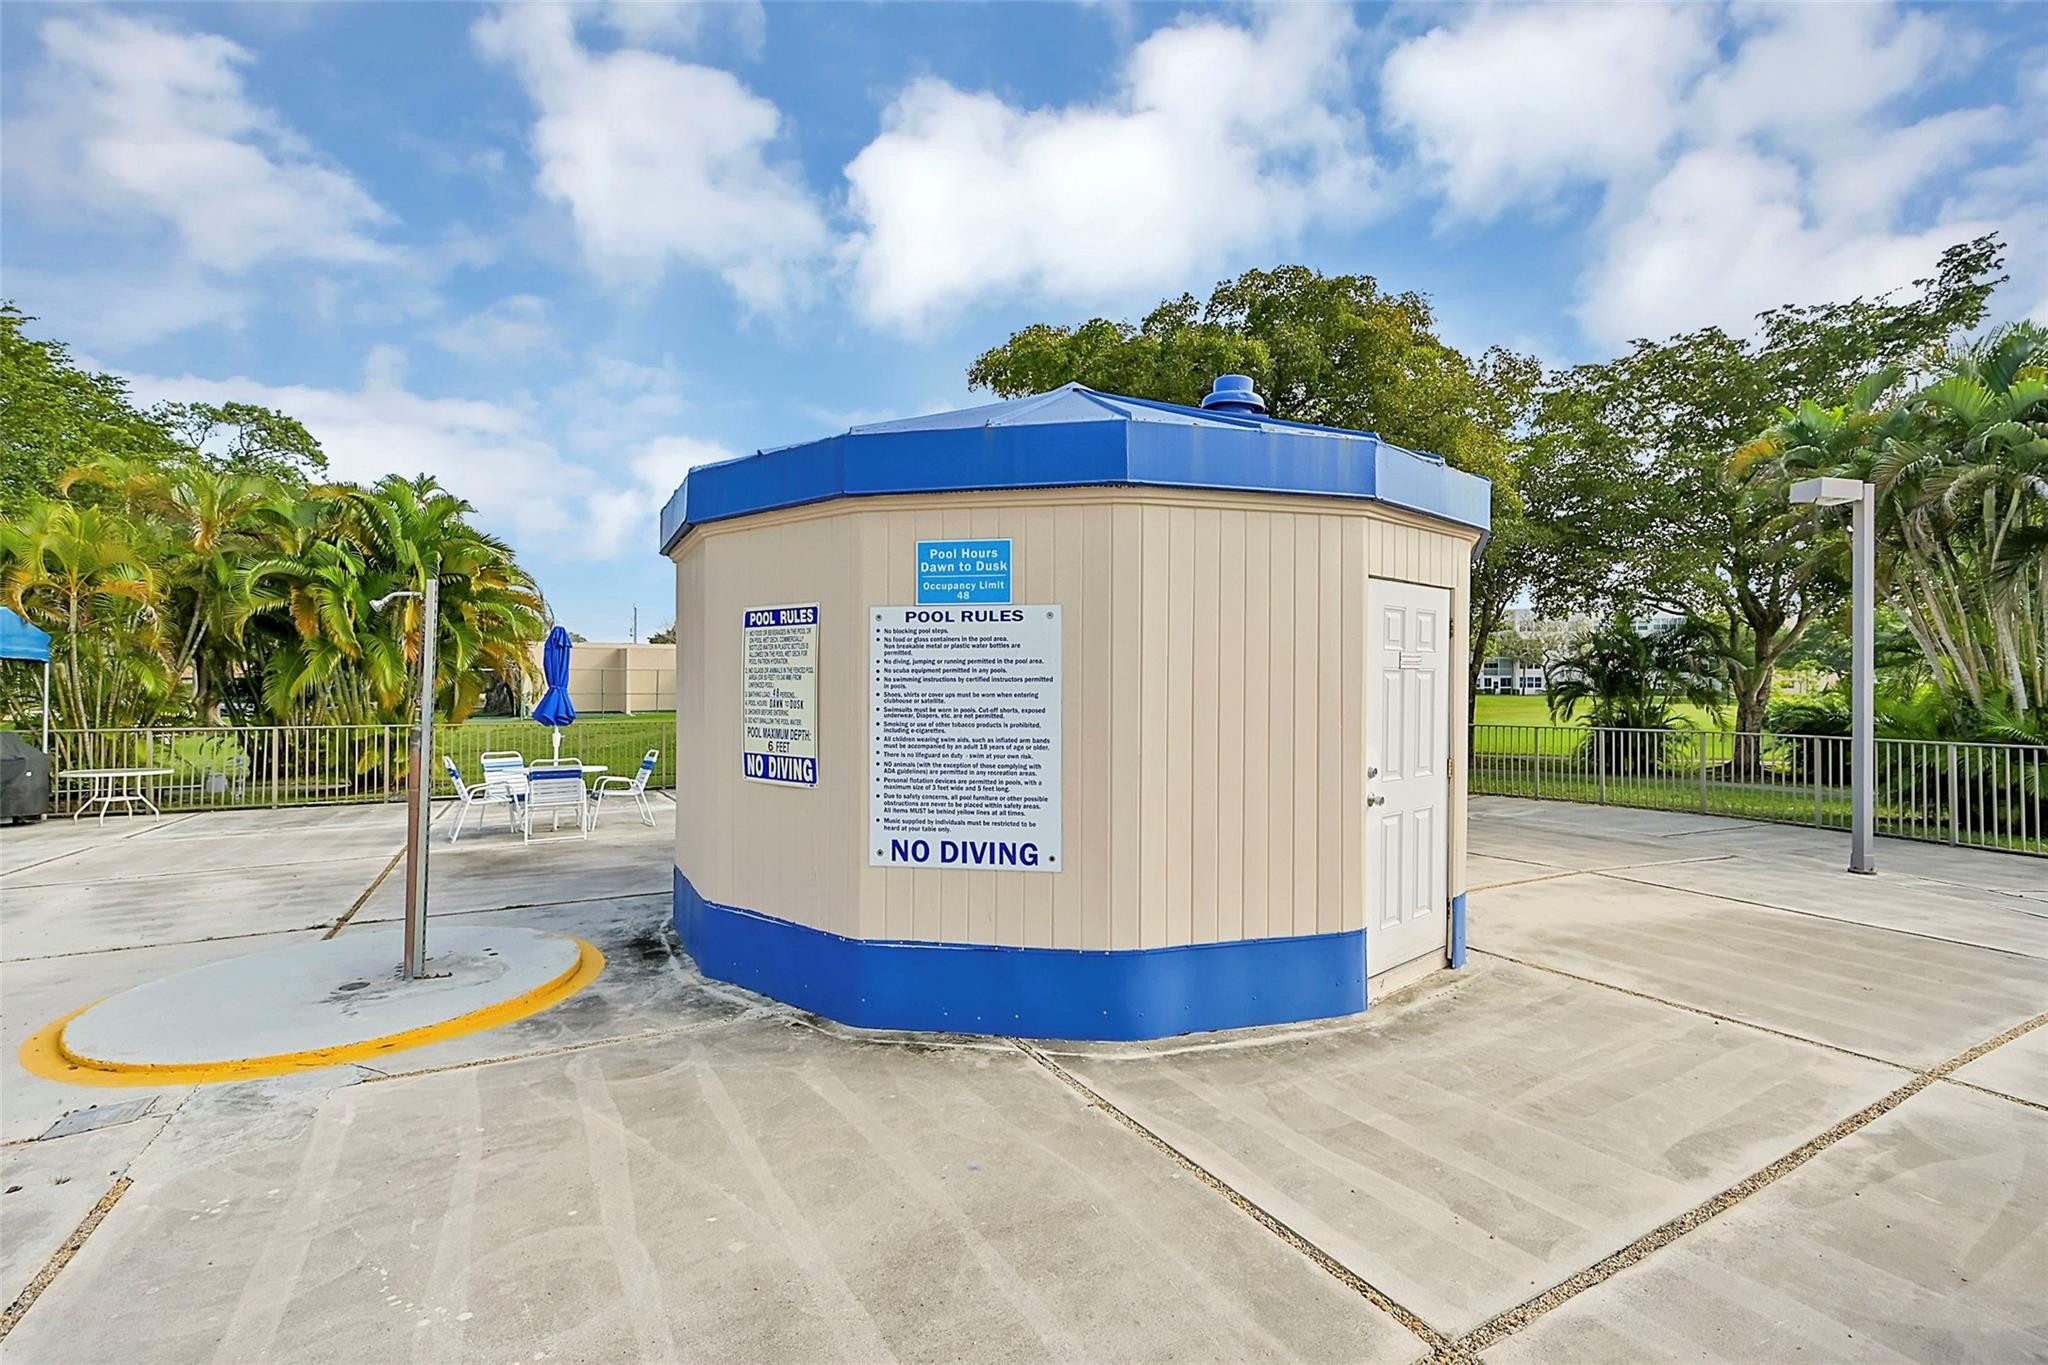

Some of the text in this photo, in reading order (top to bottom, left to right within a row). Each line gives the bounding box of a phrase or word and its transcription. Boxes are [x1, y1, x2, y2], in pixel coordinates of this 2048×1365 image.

[930, 548, 998, 559] Pool Hours
[921, 561, 1008, 572] Dawn to Dusk
[923, 581, 1004, 591] Occupancy Limit
[750, 609, 813, 626] POOL RULES
[906, 610, 1024, 622] POOL RULES
[770, 699, 783, 708] DAWN
[790, 700, 804, 709] DUSK
[748, 726, 811, 741] POOL MAXIMUM DEPTH:
[768, 741, 790, 752] 6 FEET
[747, 754, 813, 782] NO DIVING
[892, 839, 1038, 866] NO DIVING
